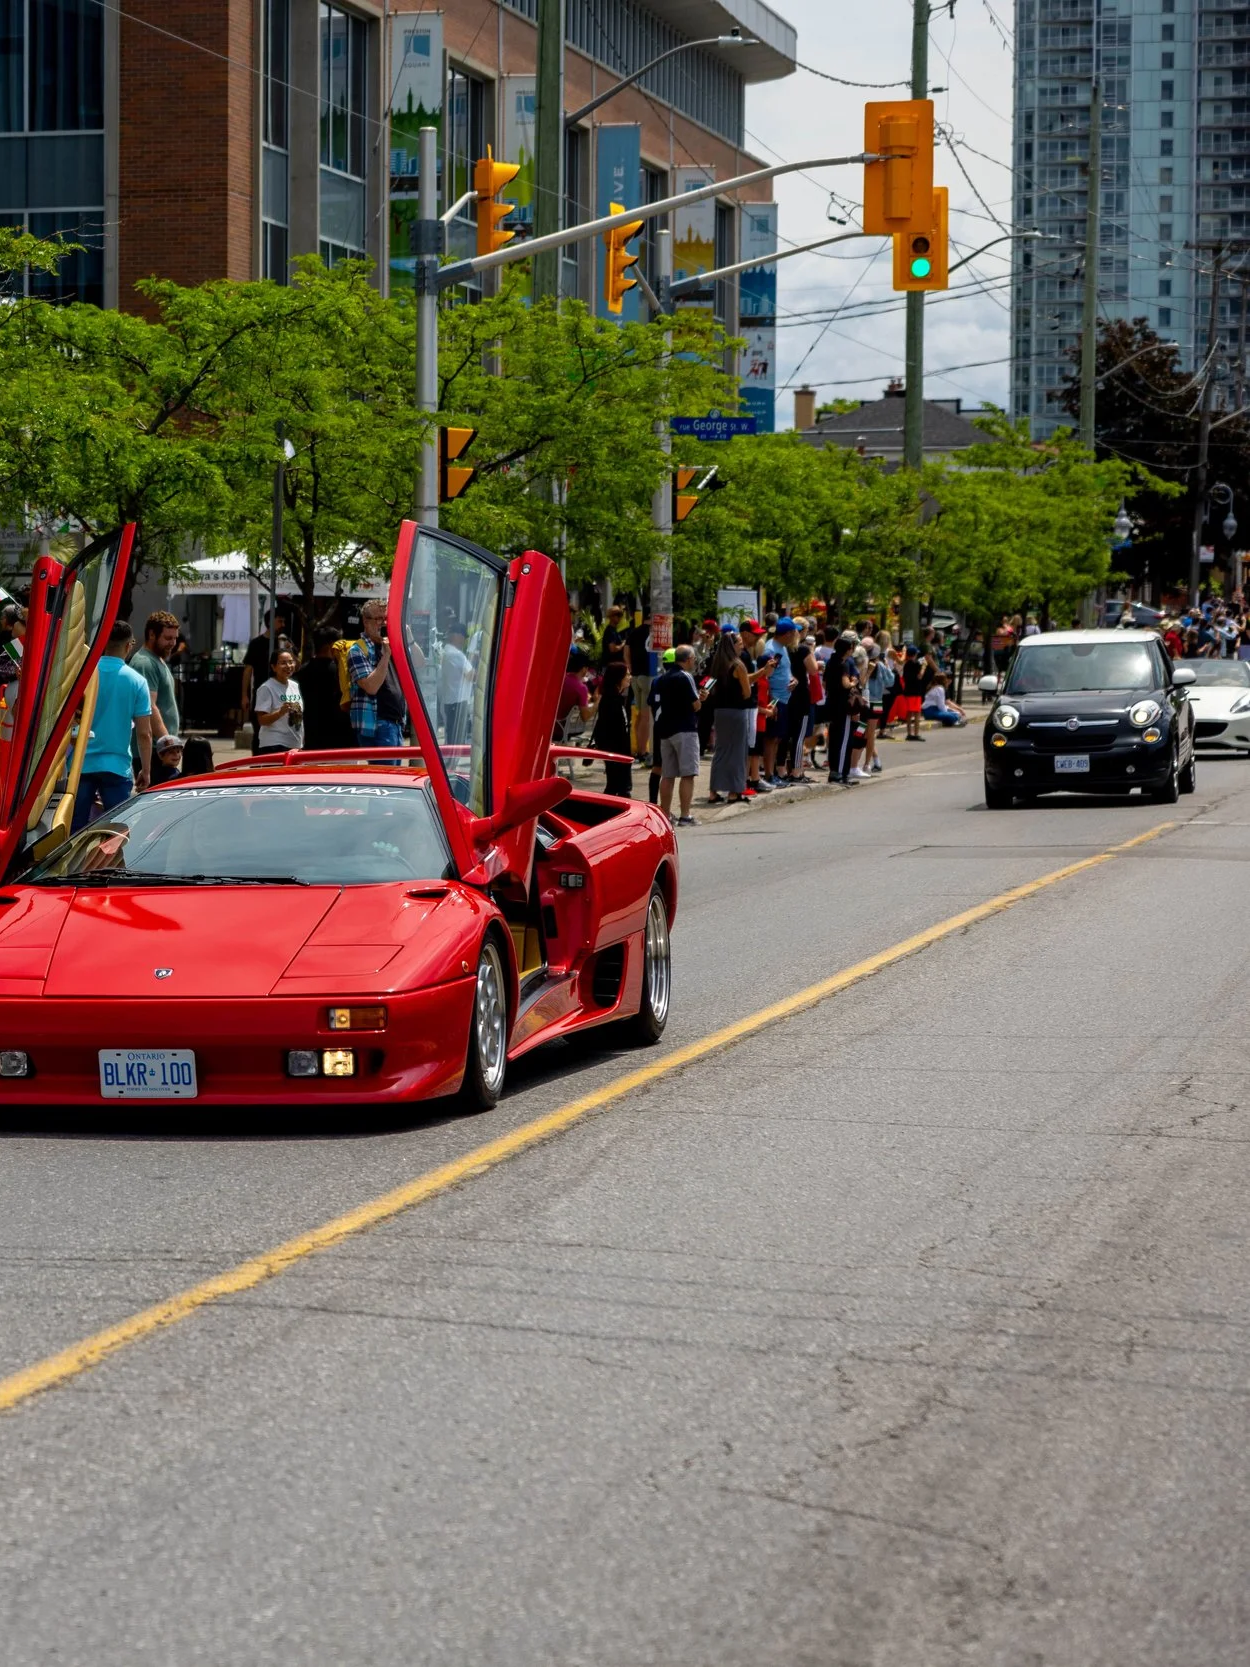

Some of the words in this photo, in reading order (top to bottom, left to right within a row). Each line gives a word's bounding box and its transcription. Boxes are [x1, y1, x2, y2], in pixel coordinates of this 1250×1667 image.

[693, 419, 728, 433] George
[222, 571, 235, 580] K9
[152, 788, 241, 801] RACE
[261, 786, 403, 796] RUNWAY
[104, 1062, 147, 1086] BLKR
[161, 1062, 192, 1086] 100
